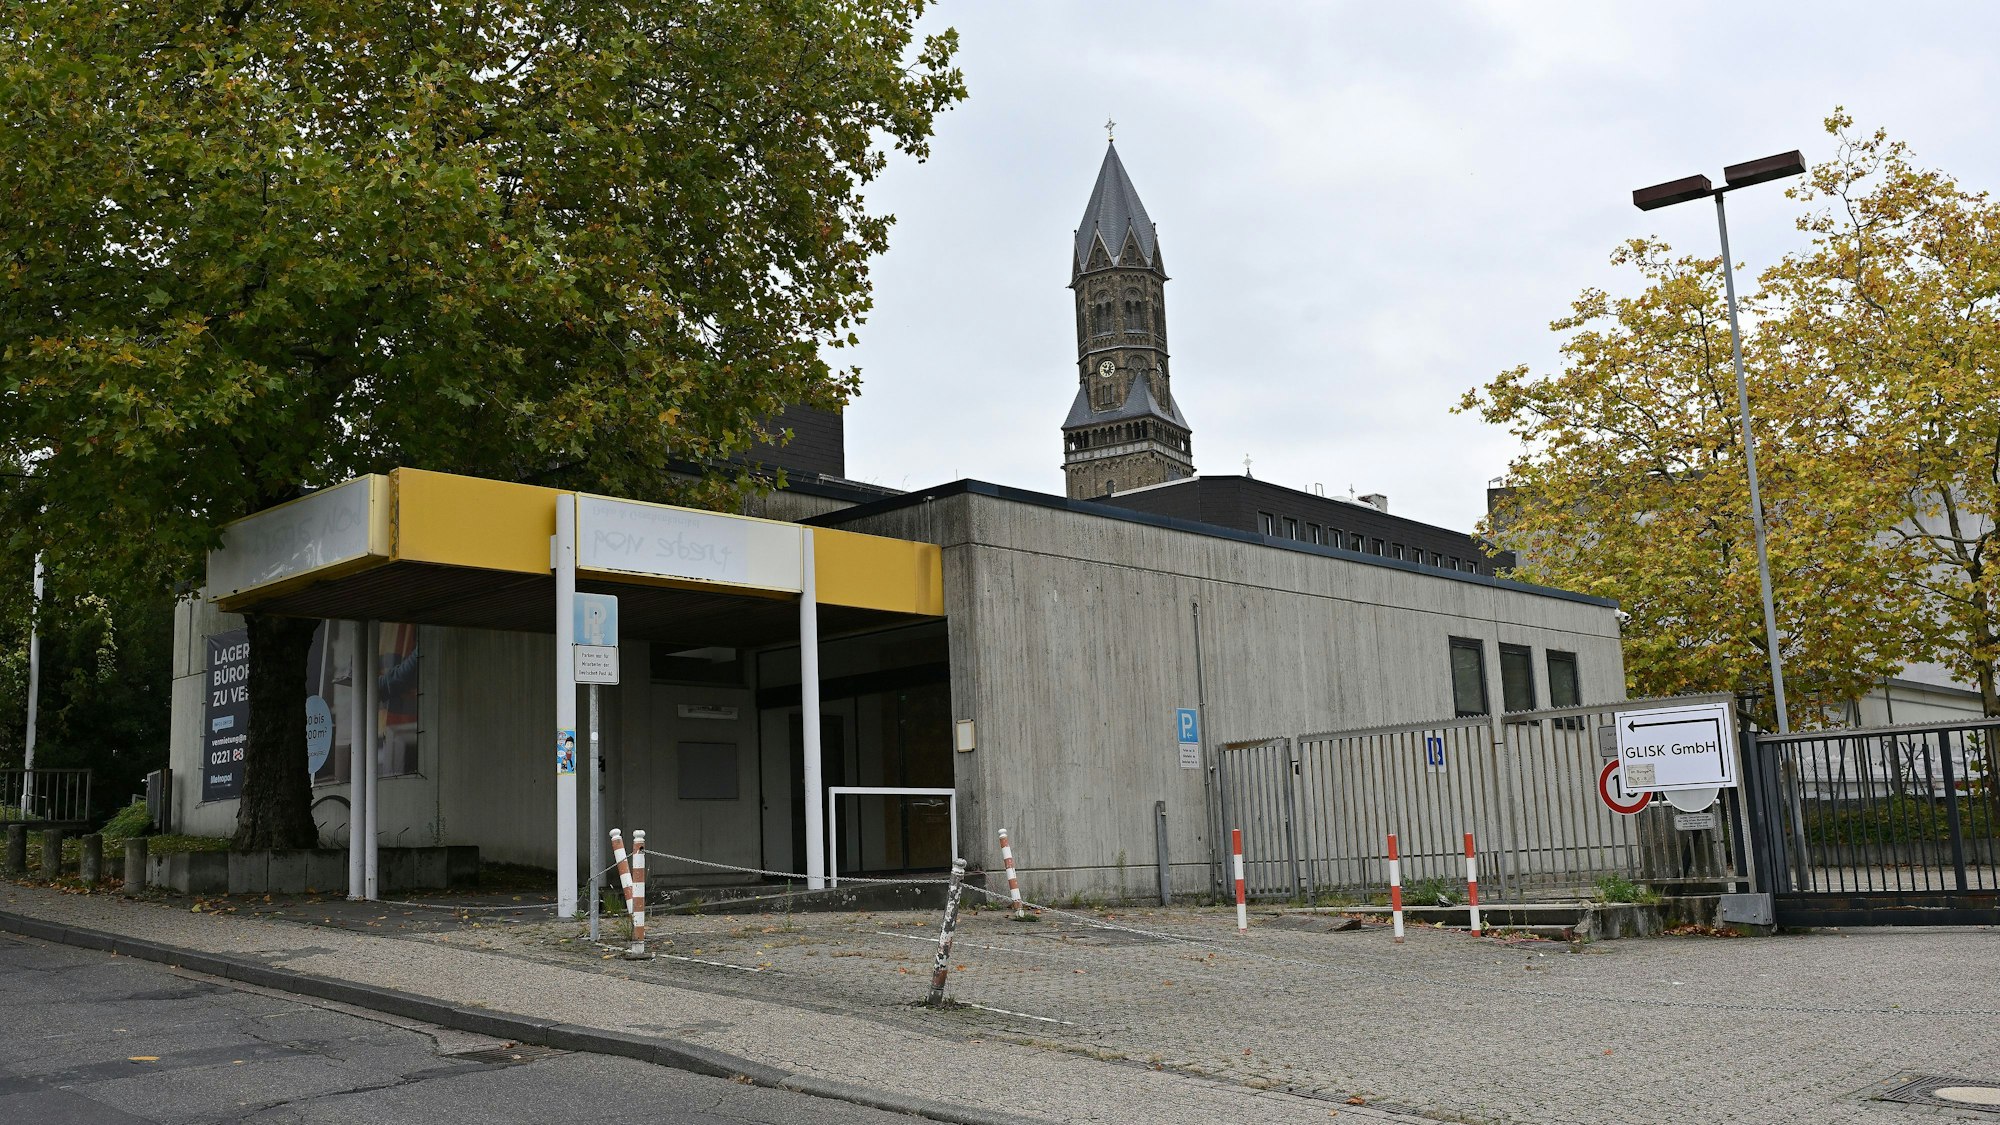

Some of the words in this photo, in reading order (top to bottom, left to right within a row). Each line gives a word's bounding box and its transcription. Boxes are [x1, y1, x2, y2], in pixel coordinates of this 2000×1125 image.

[213, 689, 228, 707] ZU
[211, 750, 231, 765] 0221
[1625, 744, 1666, 759] GLISK
[1671, 741, 1716, 756] GmbH
[210, 772, 233, 785] Metropol
